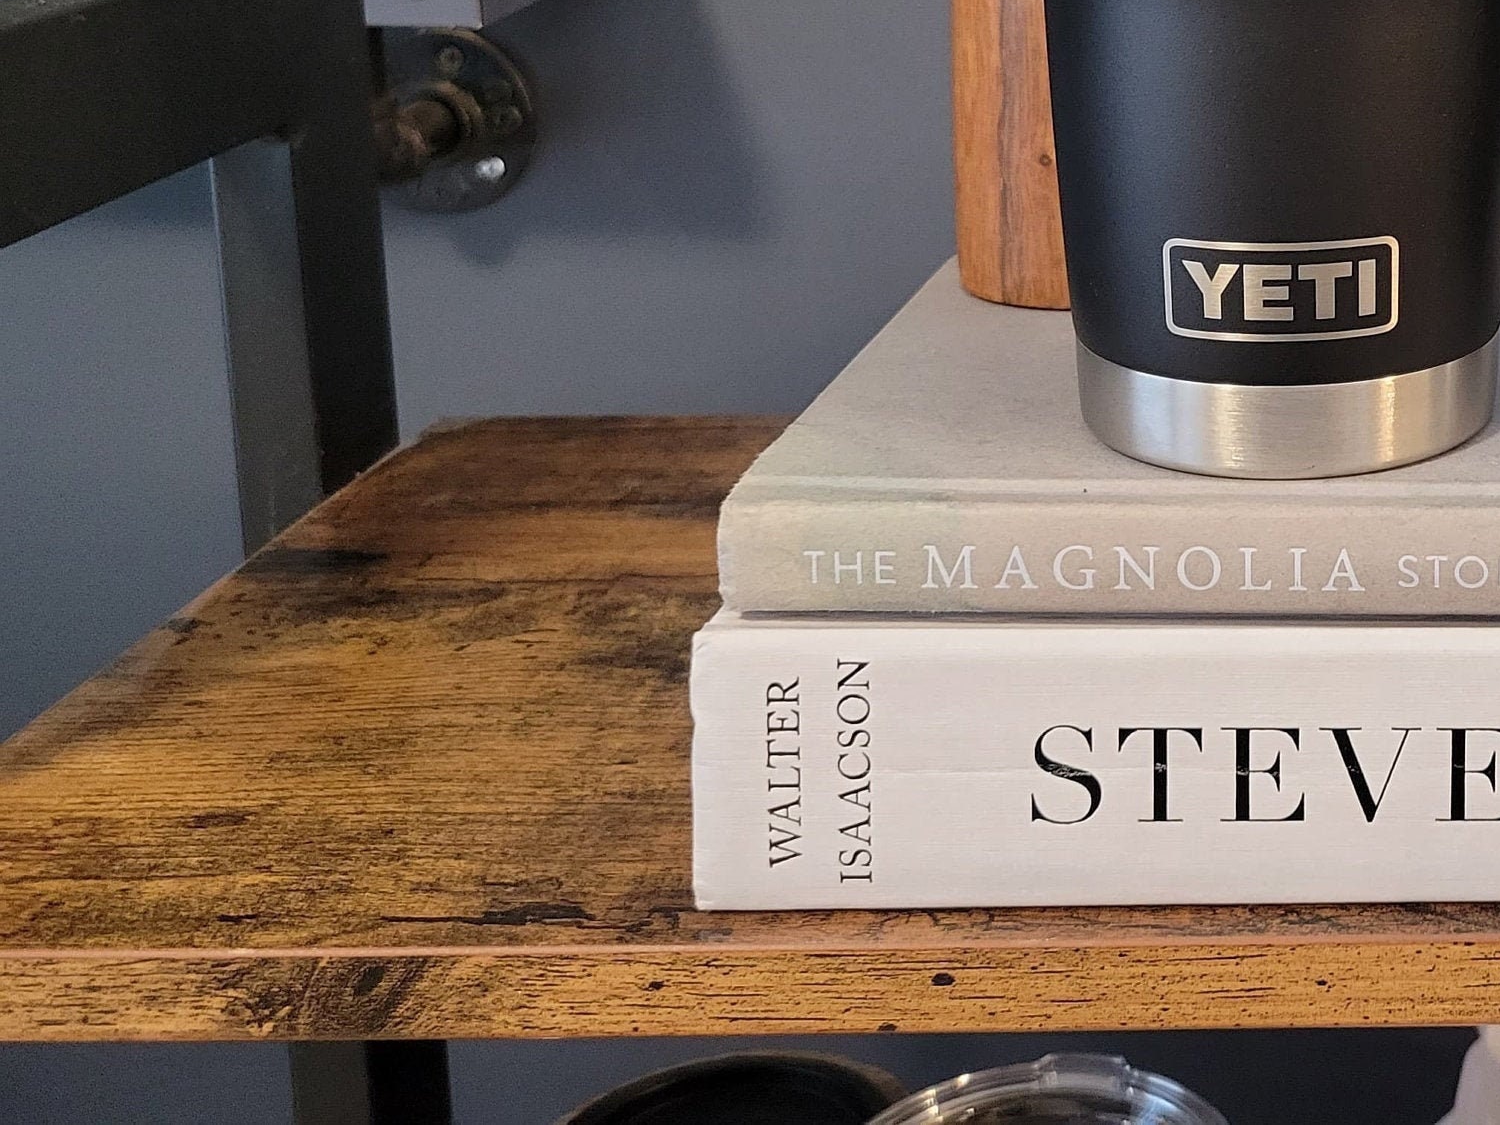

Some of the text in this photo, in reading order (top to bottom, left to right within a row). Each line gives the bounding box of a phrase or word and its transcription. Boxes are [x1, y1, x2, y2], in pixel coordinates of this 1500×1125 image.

[1181, 258, 1377, 321] YETI
[803, 550, 897, 585] THE
[920, 544, 1365, 592] MAGNOLIA
[766, 676, 803, 868] WALTER
[836, 657, 873, 884] ISAACSON
